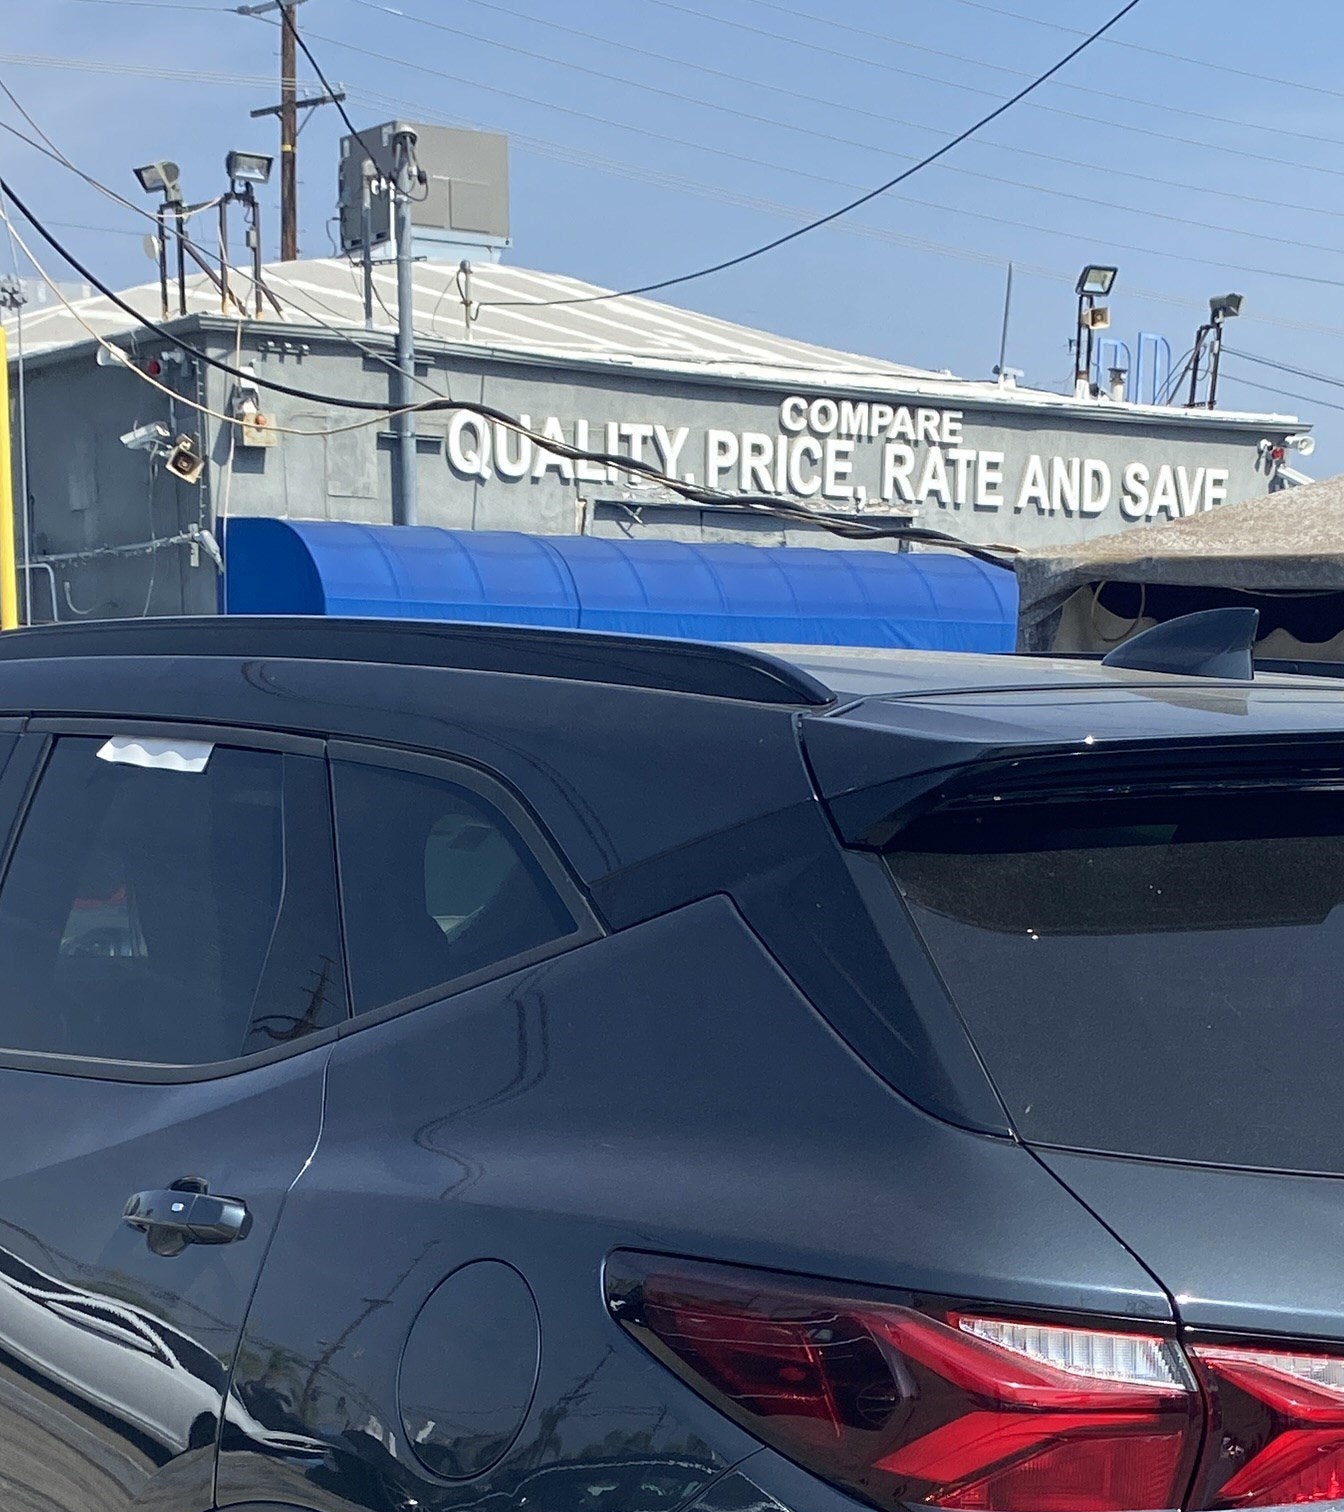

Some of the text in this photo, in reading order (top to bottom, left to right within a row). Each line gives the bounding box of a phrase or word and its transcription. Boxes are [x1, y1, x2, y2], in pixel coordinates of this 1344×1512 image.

[779, 395, 964, 444] COMPARE
[705, 428, 867, 510] PRICE,
[882, 443, 1005, 507] RATE
[1014, 454, 1113, 514] AND
[1122, 461, 1230, 522] SAVE
